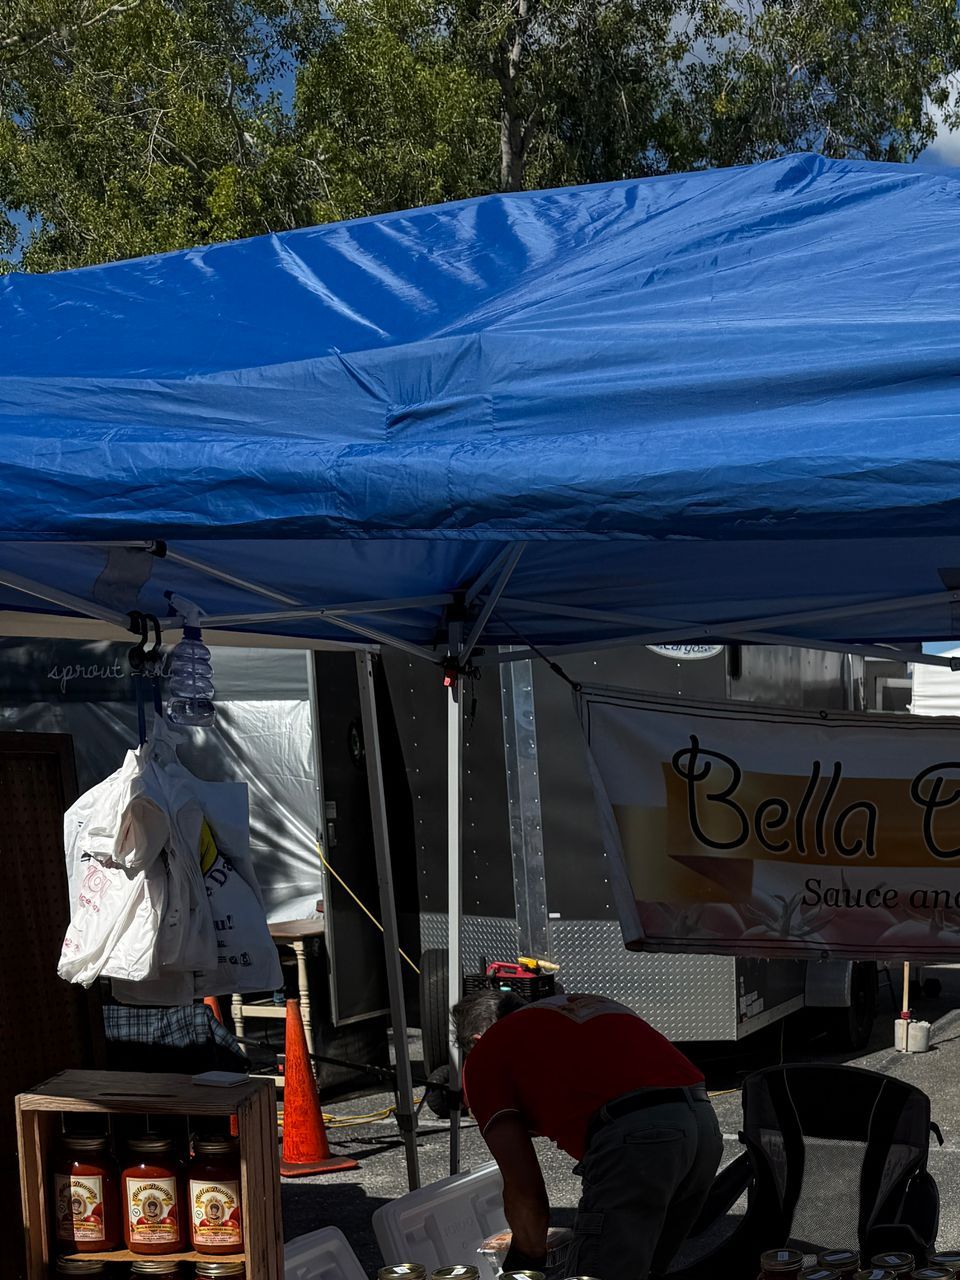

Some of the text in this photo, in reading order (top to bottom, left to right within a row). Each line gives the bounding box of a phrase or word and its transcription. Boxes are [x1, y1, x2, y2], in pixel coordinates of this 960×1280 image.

[47, 657, 125, 694] sprout
[672, 735, 877, 857] Bella
[802, 877, 898, 910] Sauce
